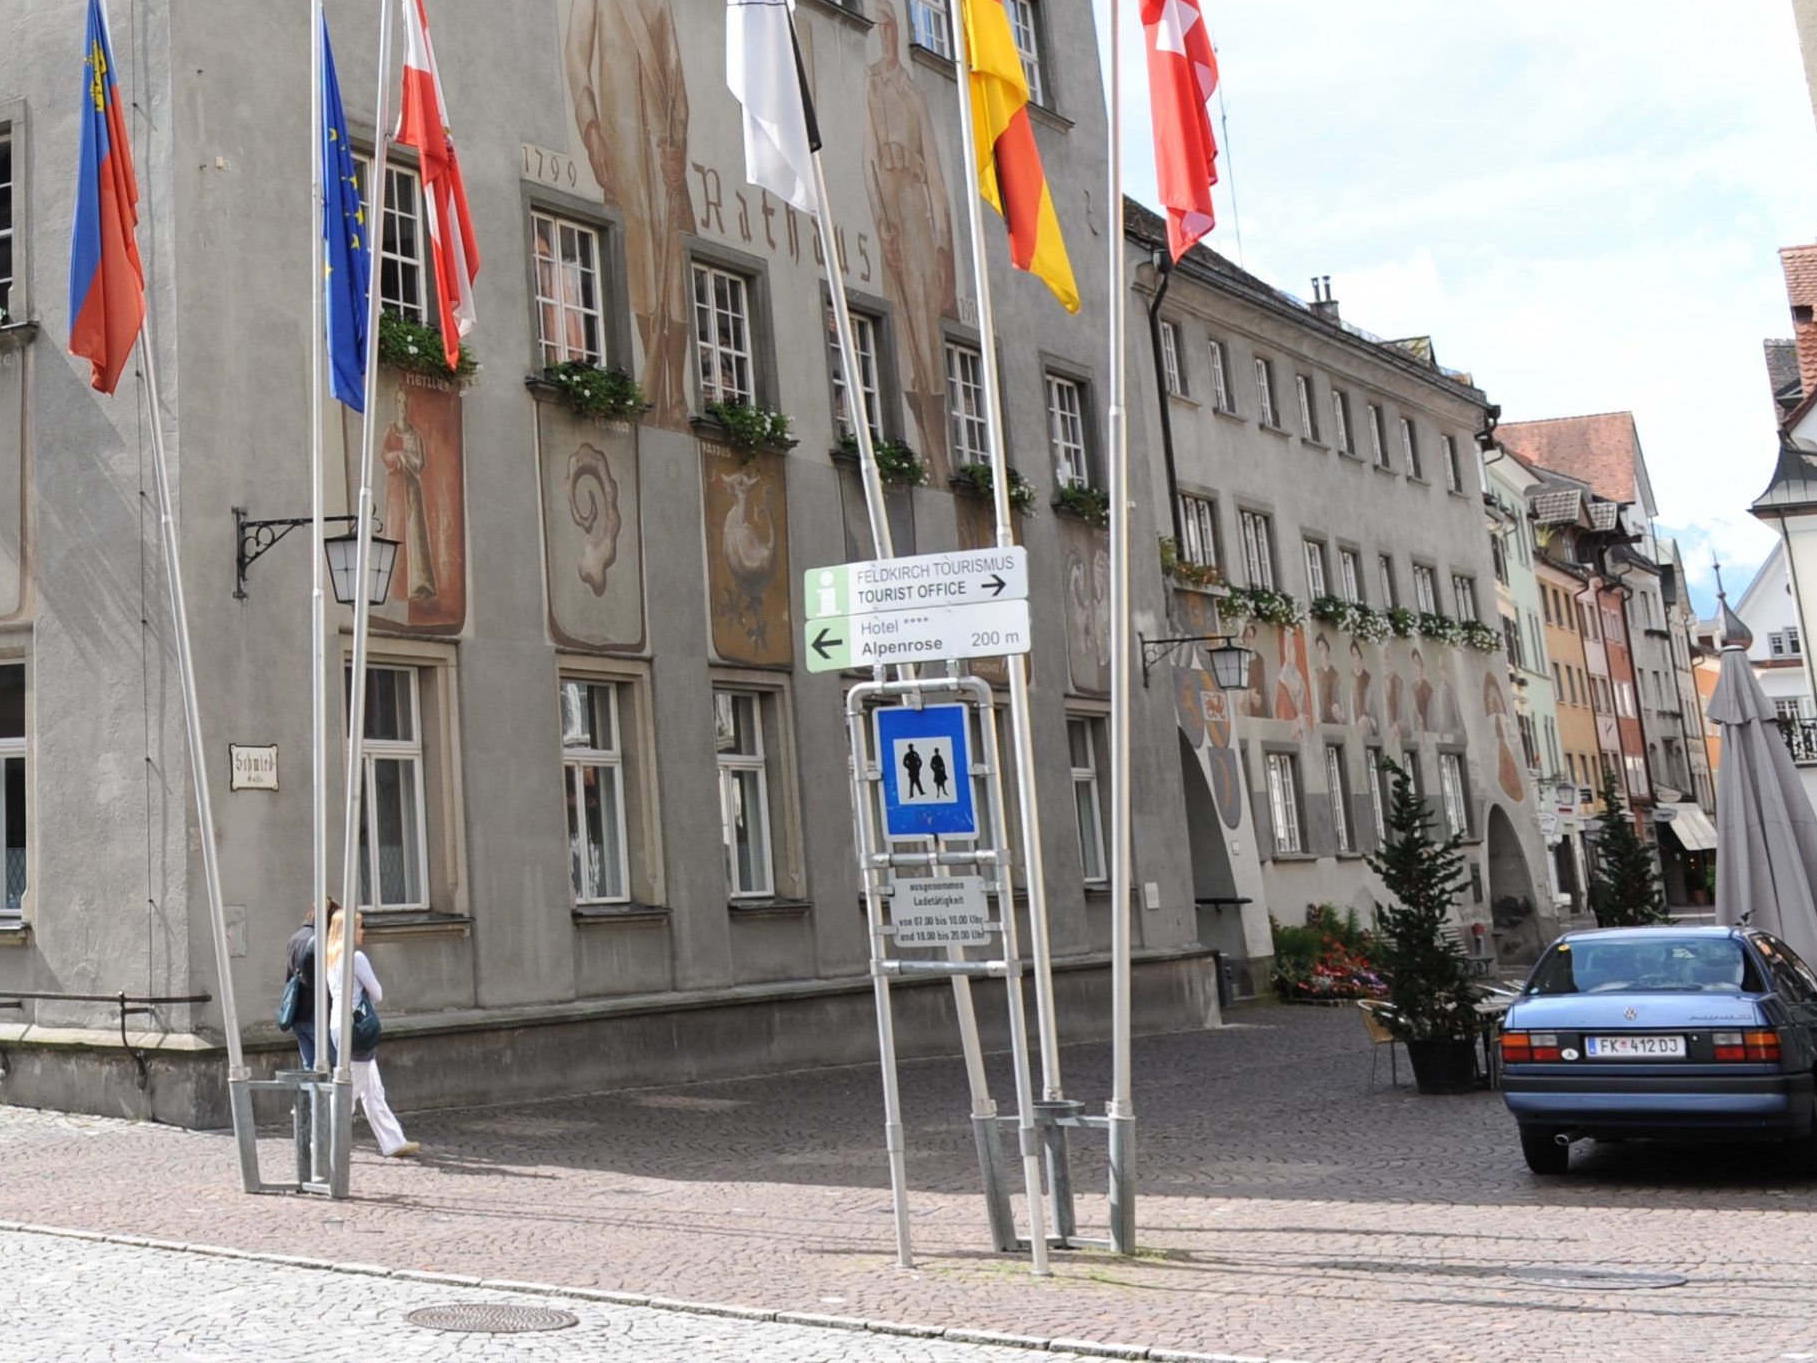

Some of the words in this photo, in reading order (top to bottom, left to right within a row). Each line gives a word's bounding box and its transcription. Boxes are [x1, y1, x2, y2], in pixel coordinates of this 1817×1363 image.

[523, 145, 577, 188] 1799
[857, 563, 930, 585] FELDKIRCH
[933, 555, 1015, 576] TOURISMUS
[857, 585, 914, 604] TOURIST
[917, 580, 967, 599] OFFICE
[860, 619, 899, 636] Hotel
[971, 631, 1001, 648] 200
[1005, 631, 1020, 644] m
[861, 638, 944, 659] Alpenrose
[909, 881, 965, 893] ausgenommen
[935, 916, 947, 926] bis
[937, 930, 950, 941] bis
[1600, 1038, 1619, 1054] FK
